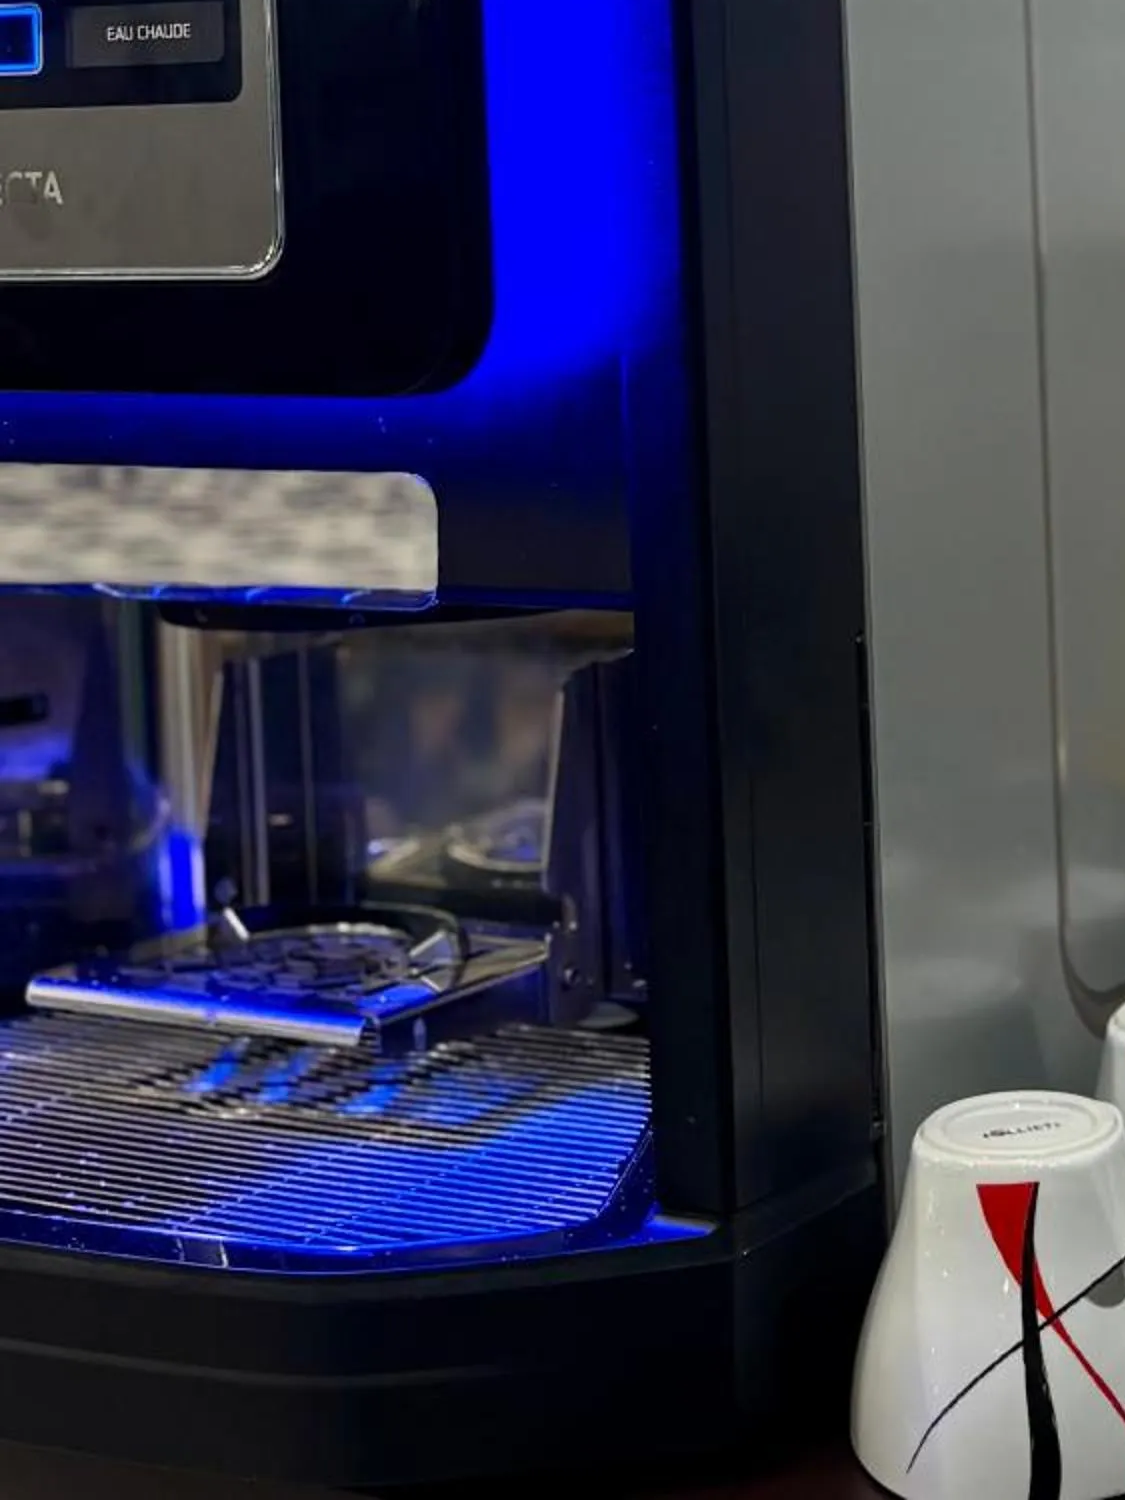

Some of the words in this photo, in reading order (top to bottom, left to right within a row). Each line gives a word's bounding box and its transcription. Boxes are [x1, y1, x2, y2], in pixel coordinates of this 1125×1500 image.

[106, 24, 134, 42] EAU
[136, 22, 192, 41] CHAUDE
[0, 170, 64, 205] CTA
